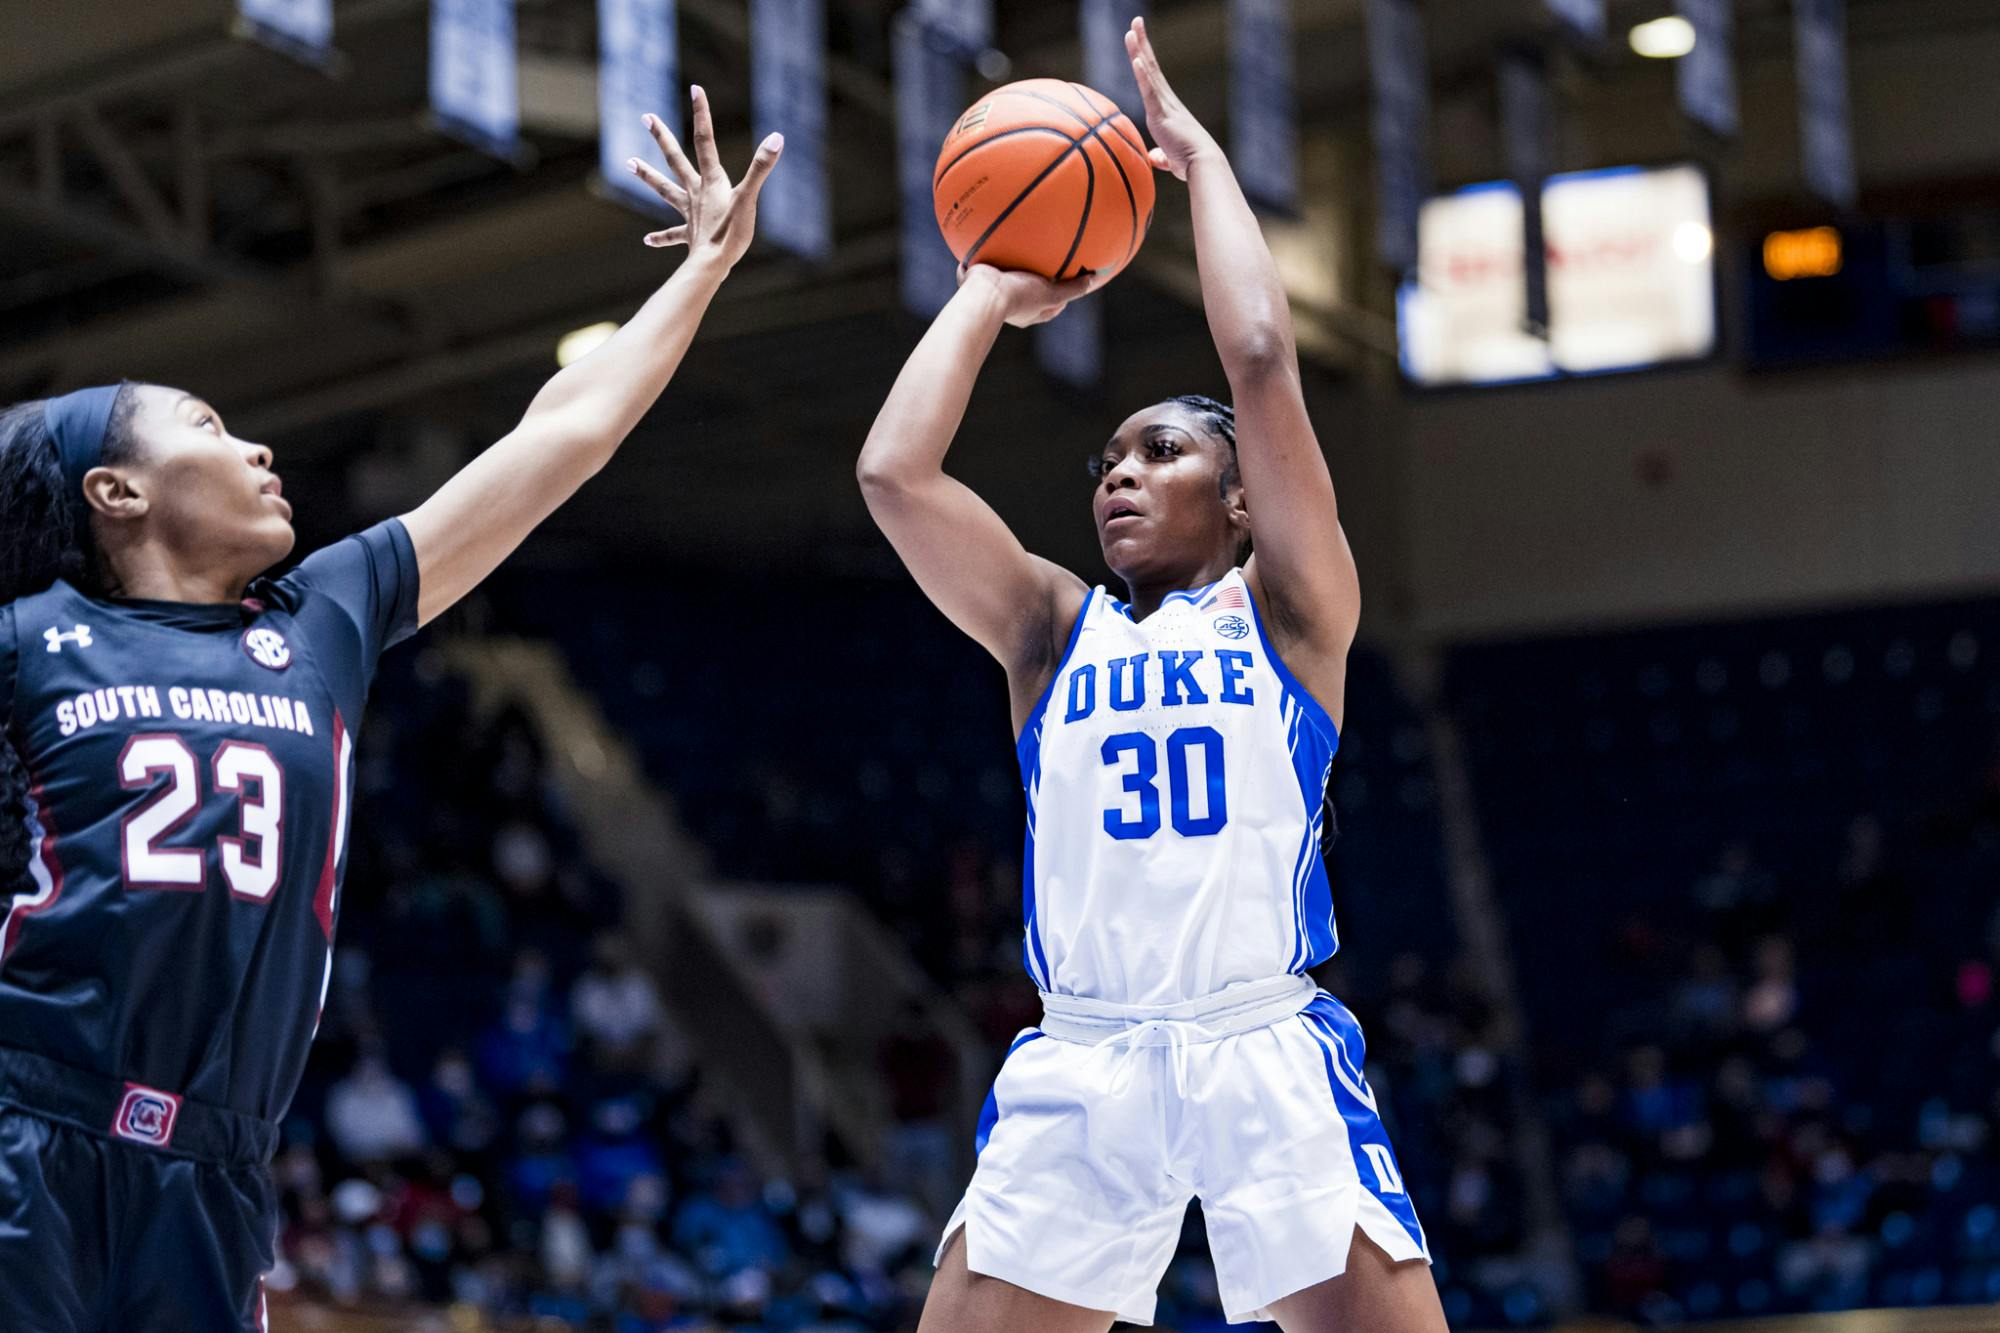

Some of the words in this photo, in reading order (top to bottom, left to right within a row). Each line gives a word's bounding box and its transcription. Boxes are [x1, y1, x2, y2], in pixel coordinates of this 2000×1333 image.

[246, 628, 290, 667] SEC
[56, 685, 161, 736] SOUTH
[168, 686, 314, 736] CAROLINA
[1064, 649, 1254, 724] DUKE
[117, 733, 286, 904] 23
[1100, 726, 1228, 840] 30
